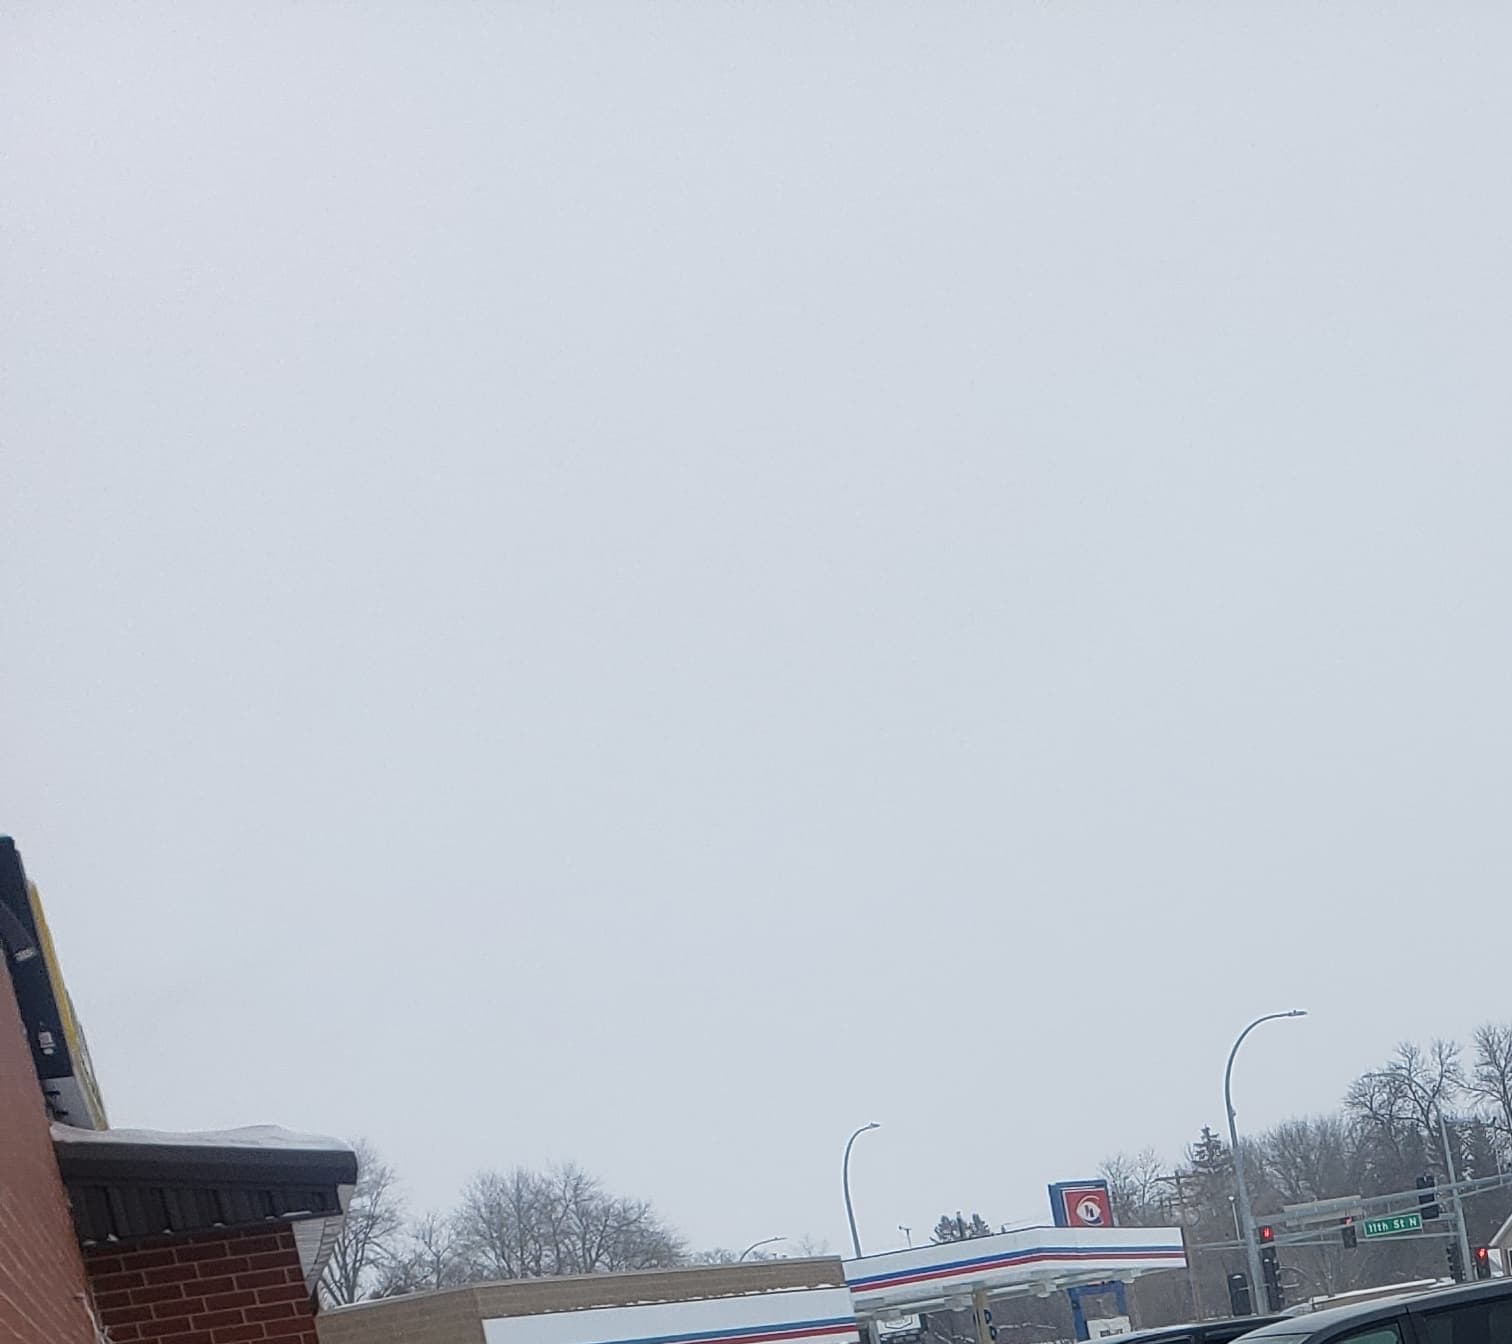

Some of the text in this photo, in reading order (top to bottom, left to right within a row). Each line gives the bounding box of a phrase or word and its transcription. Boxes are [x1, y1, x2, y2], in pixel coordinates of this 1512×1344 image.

[1368, 1216, 1417, 1233] 11th St N
